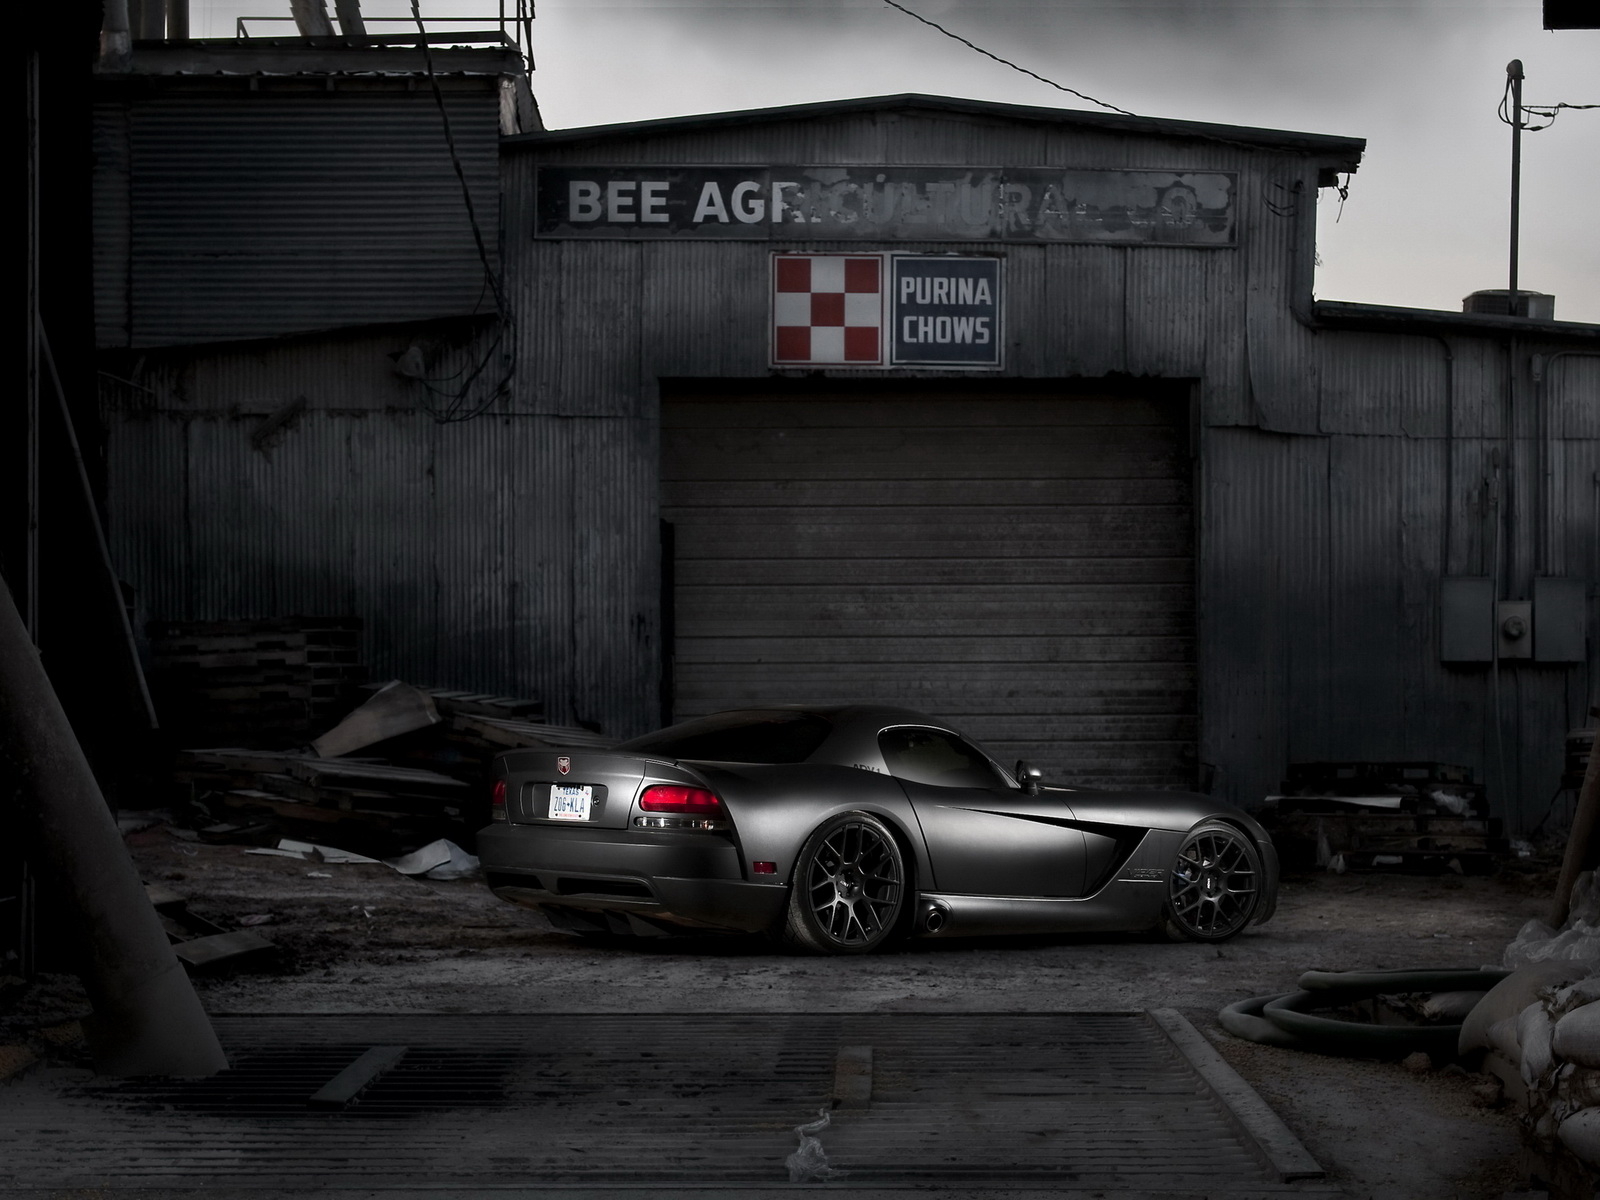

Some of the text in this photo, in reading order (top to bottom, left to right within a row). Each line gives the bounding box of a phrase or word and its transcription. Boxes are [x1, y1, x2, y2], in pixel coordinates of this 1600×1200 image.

[568, 180, 669, 223] BEE
[900, 276, 992, 306] PURINA
[902, 315, 990, 345] CHOWS
